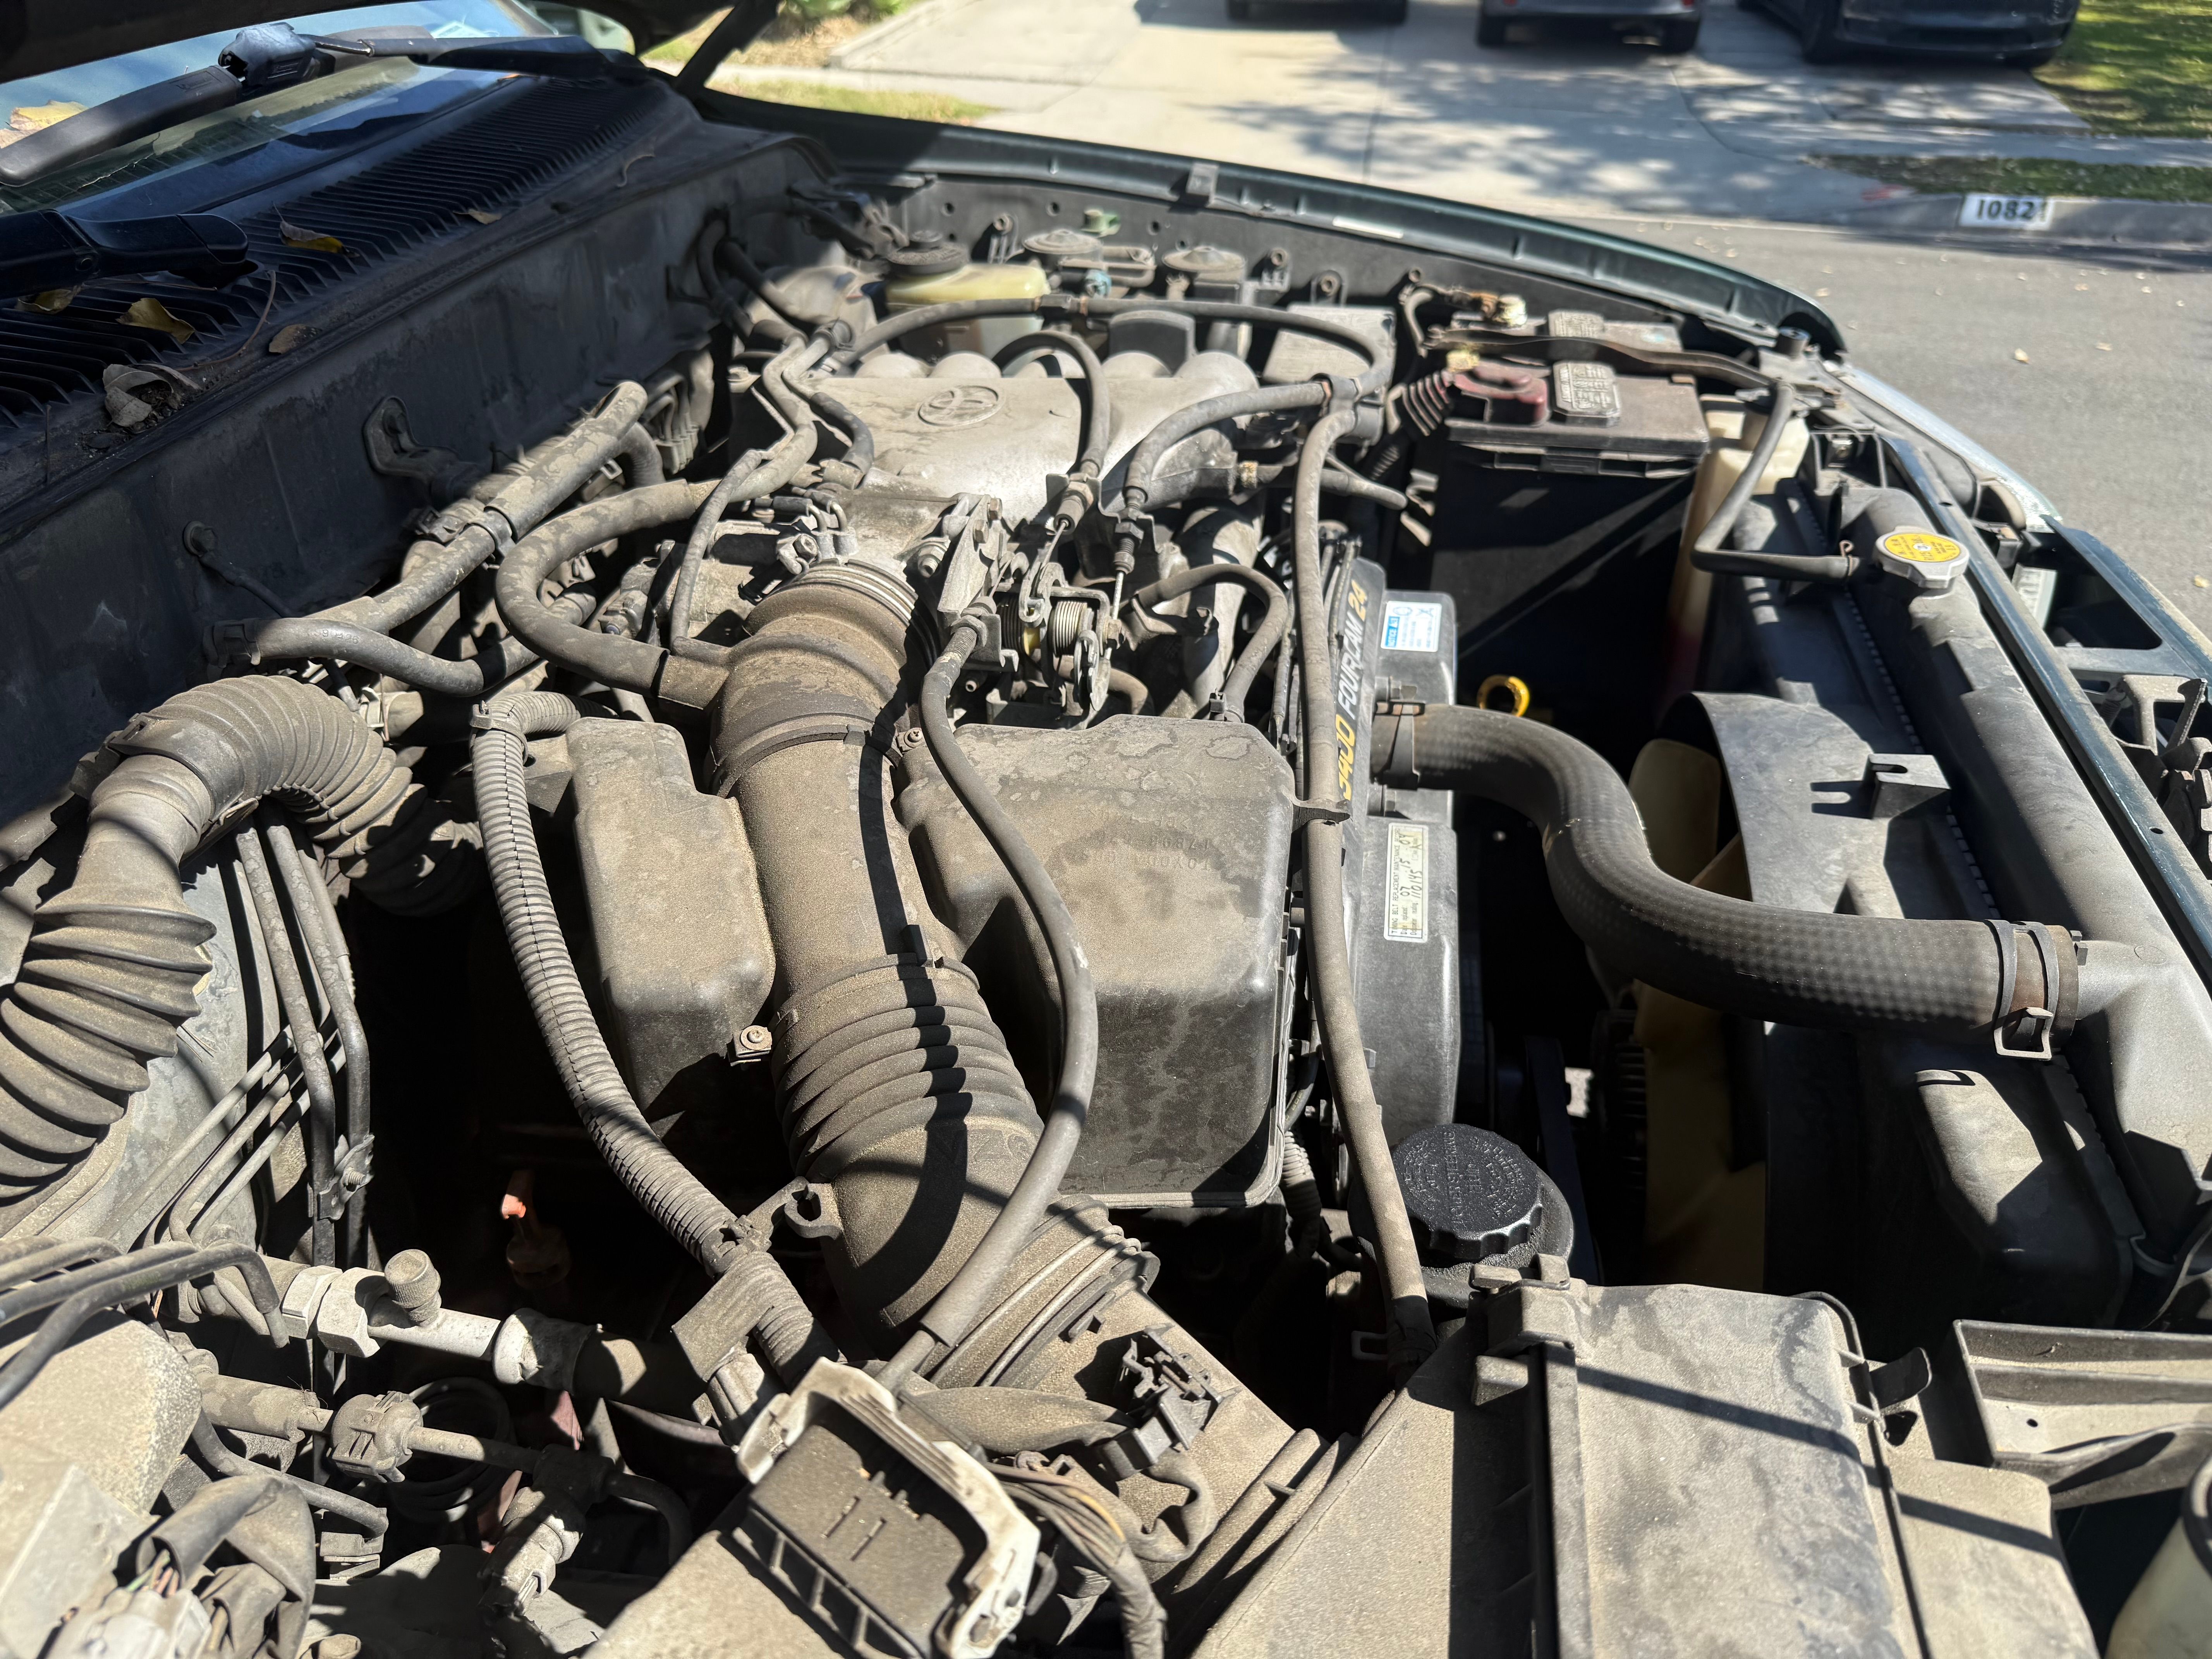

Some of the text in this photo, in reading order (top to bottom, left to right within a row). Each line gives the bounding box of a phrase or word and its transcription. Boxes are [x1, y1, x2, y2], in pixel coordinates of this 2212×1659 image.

[1977, 199, 2047, 222] 10821
[1348, 579, 1368, 622] 24
[1338, 613, 1364, 720] FOURCAM
[1400, 858, 1410, 869] 15
[1400, 886, 1410, 896] 07
[1408, 869, 1422, 899] 110145
[1443, 1131, 1460, 1183] STEERING
